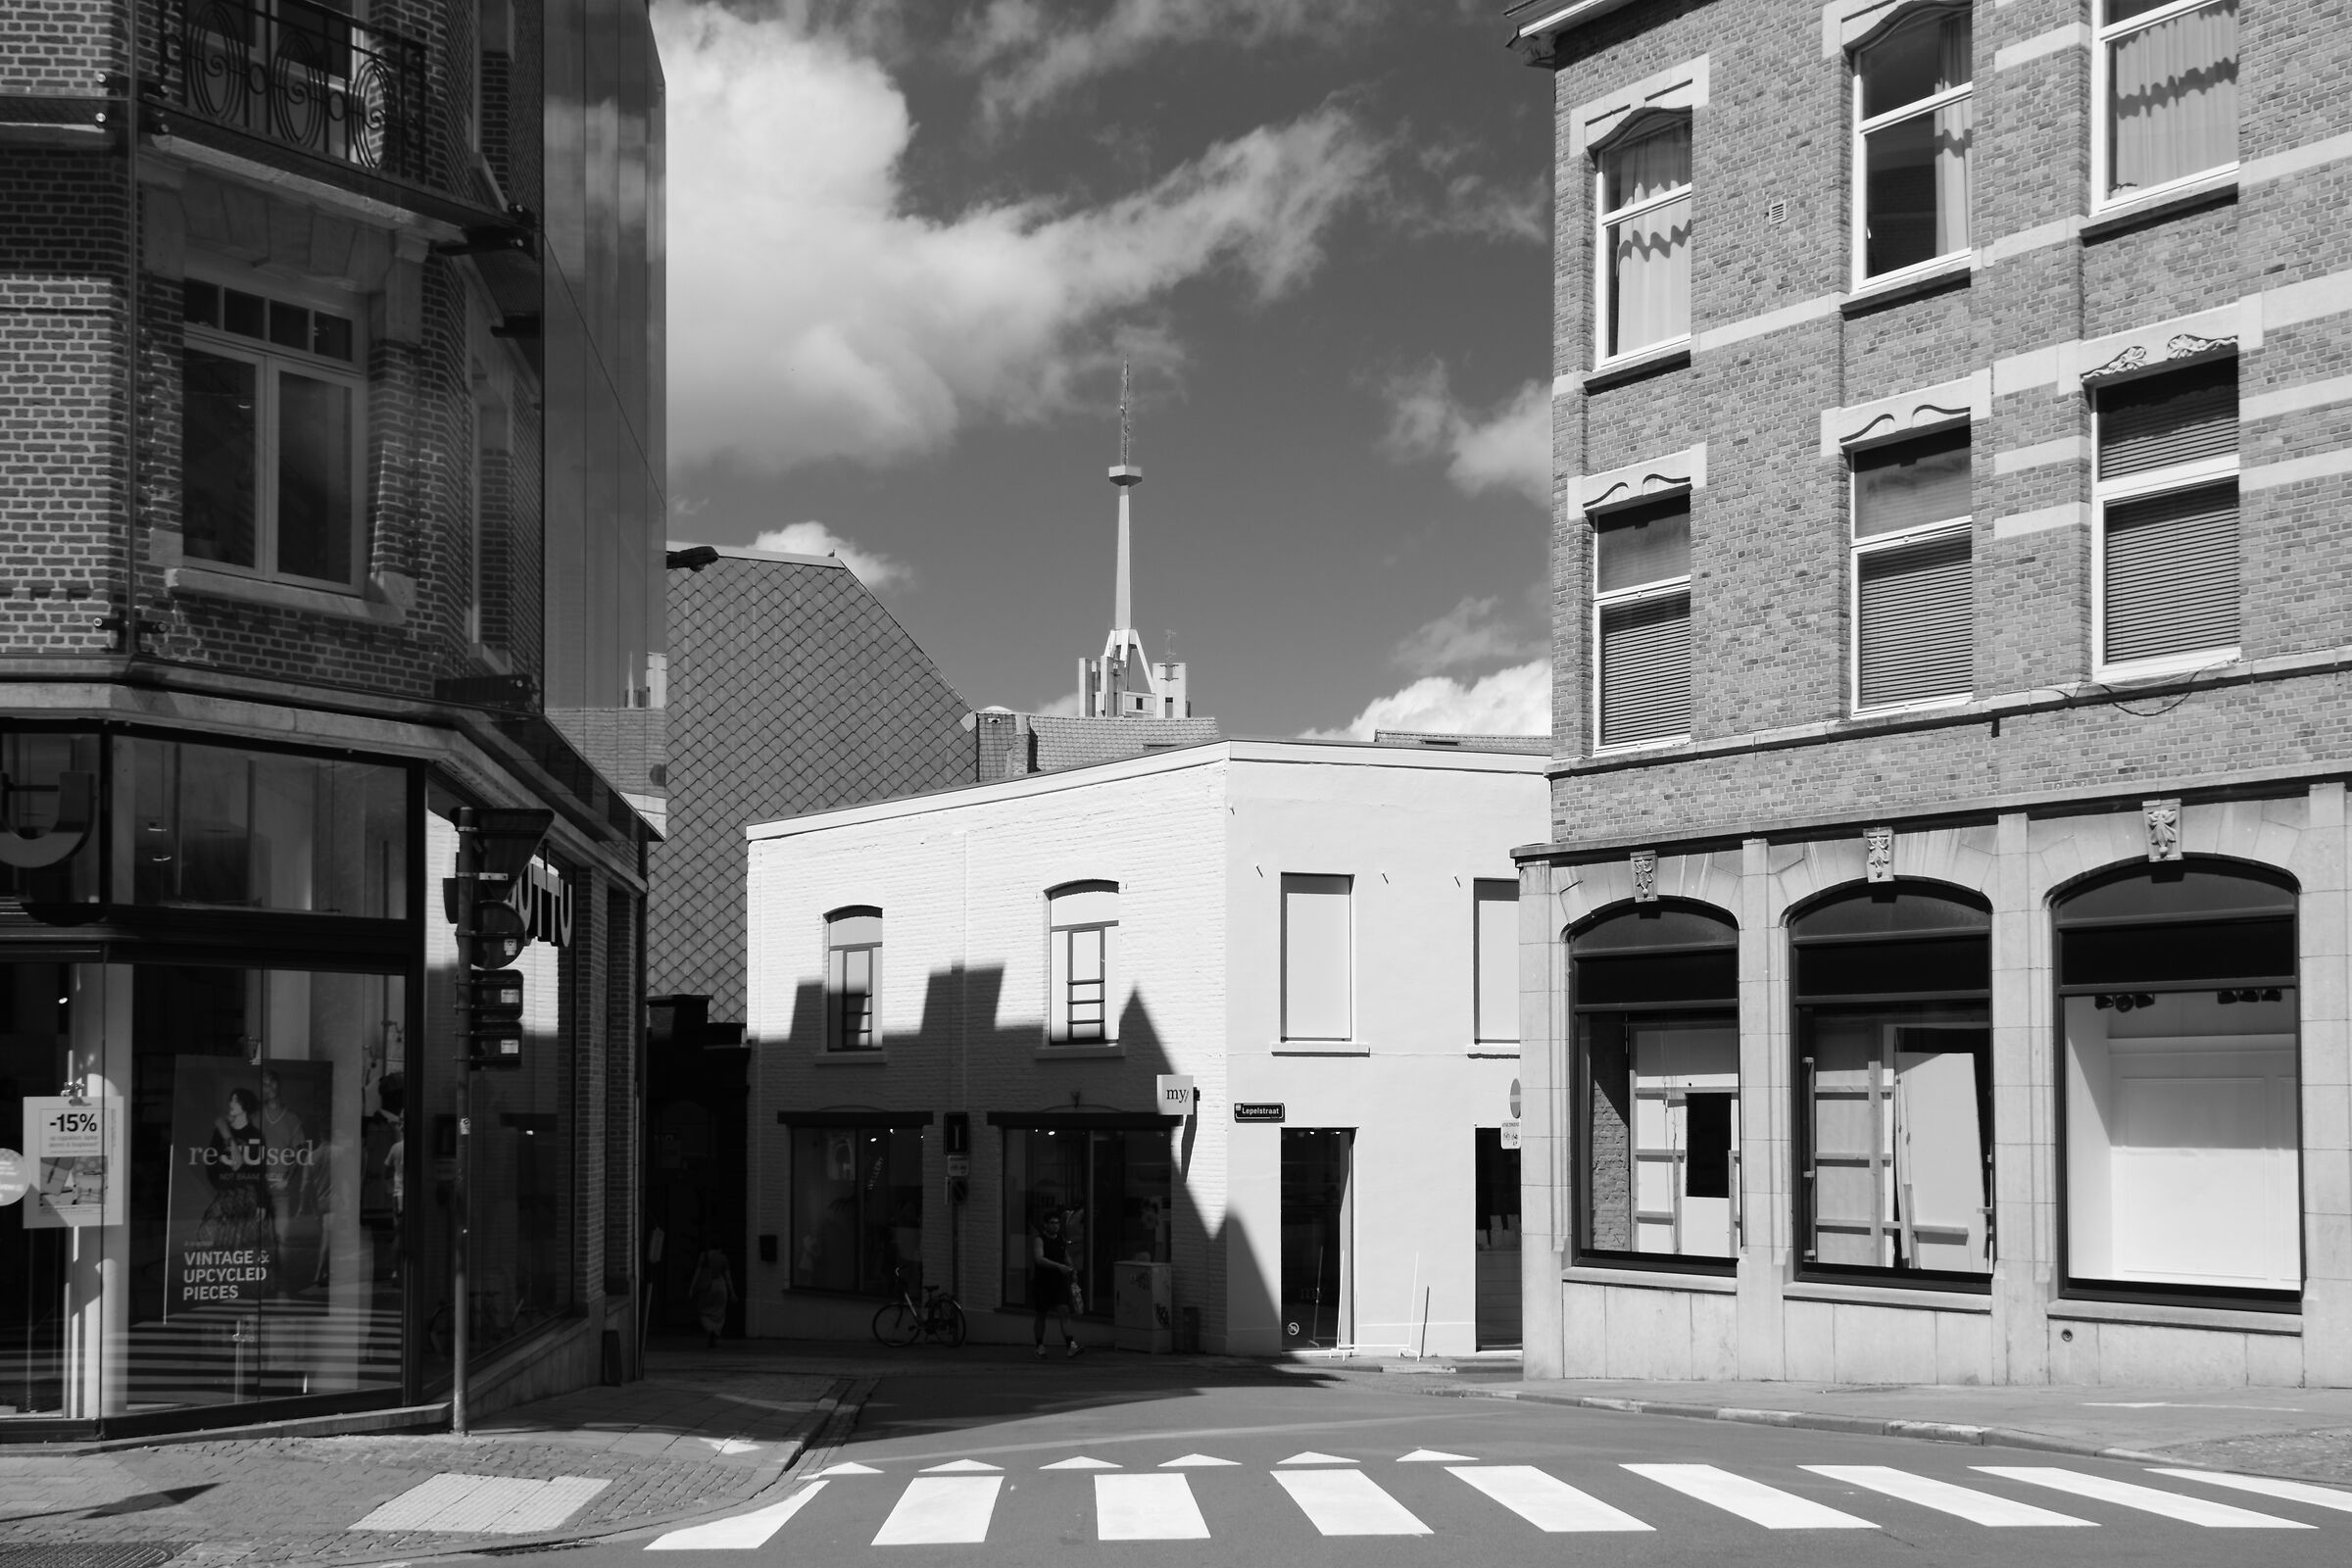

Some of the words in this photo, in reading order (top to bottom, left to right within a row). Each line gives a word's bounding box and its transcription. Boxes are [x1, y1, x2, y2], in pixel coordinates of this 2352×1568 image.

[1242, 1107, 1280, 1116] Lepelstraat
[49, 1113, 97, 1132] -15%
[183, 1250, 254, 1266] VINTAGE
[258, 1250, 270, 1264] &
[183, 1267, 268, 1284] UPCYCLED
[182, 1285, 239, 1301] PIECES
